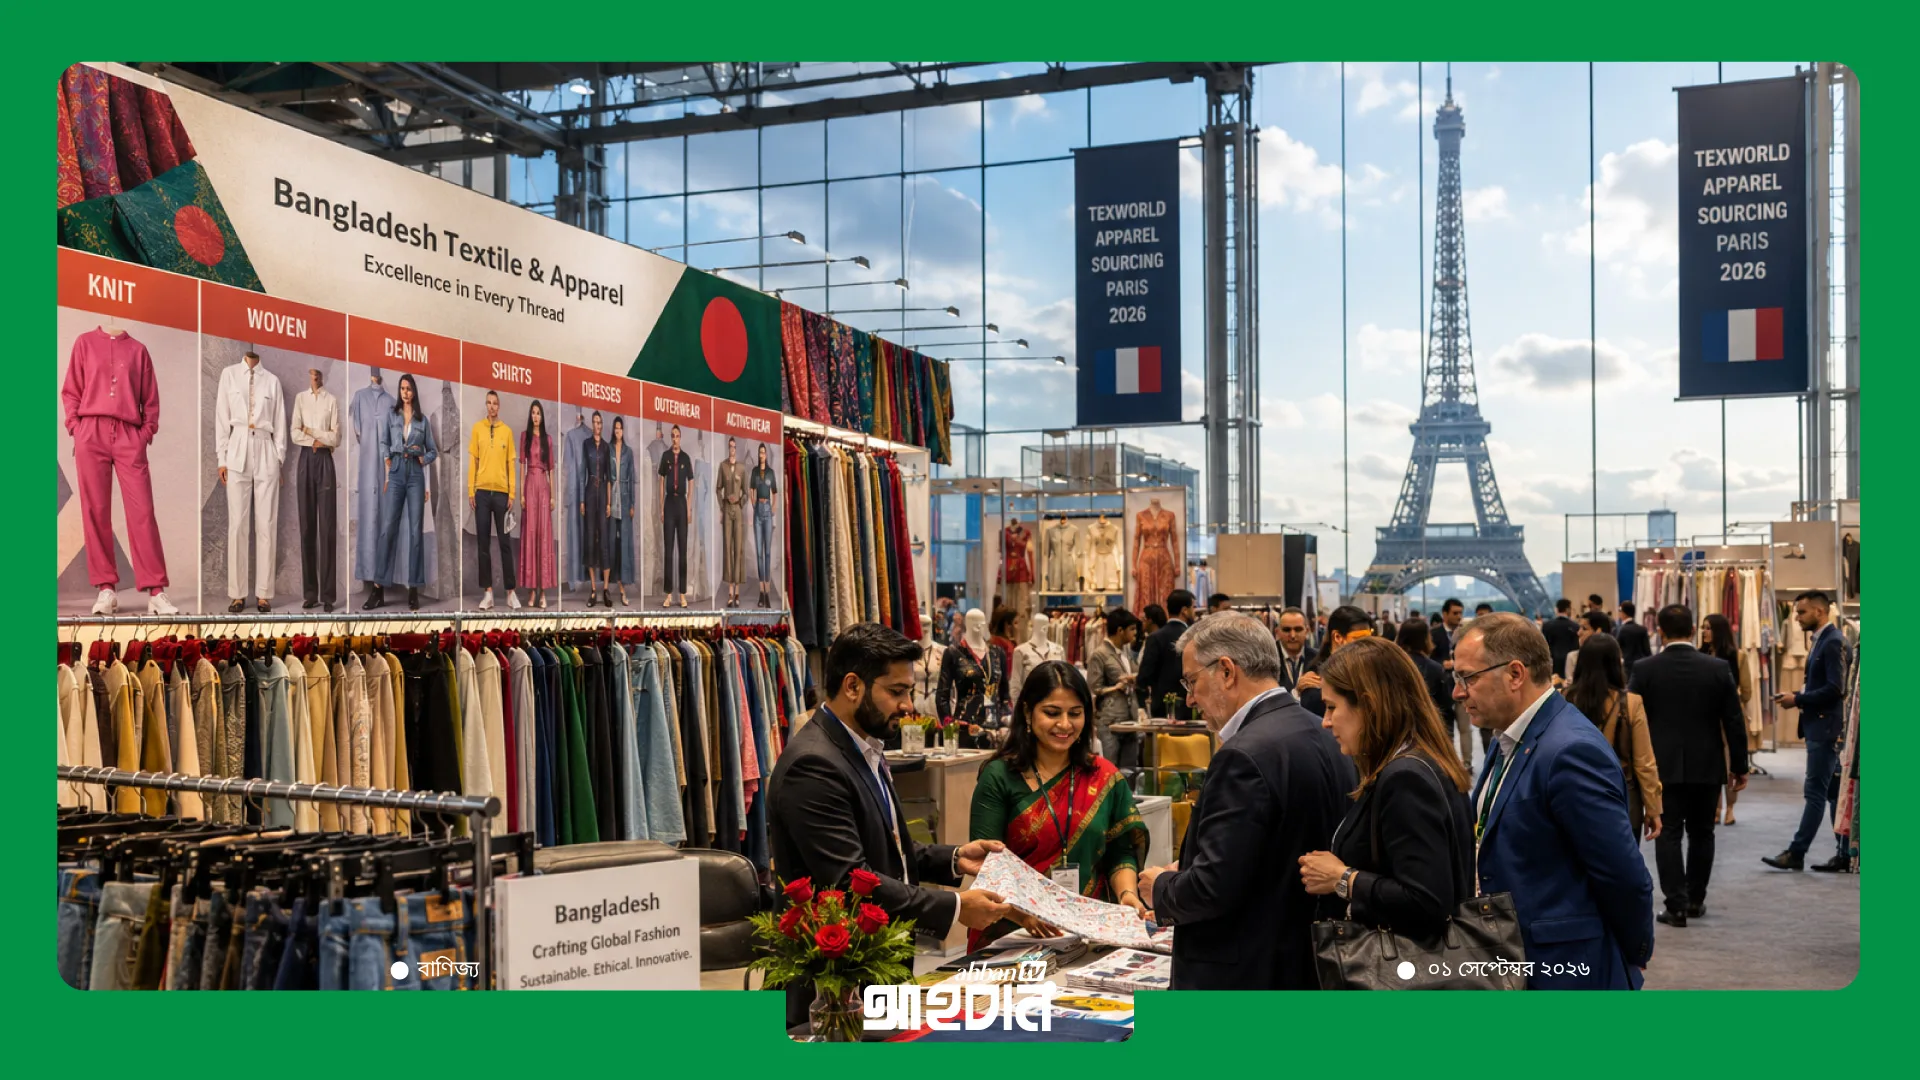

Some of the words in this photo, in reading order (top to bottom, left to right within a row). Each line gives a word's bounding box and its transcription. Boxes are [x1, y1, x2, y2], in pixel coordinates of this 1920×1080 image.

[1694, 143, 1790, 167] TEXWORLD
[1703, 173, 1782, 196] APPAREL
[1088, 201, 1166, 221] TEXWORLD
[1697, 201, 1788, 225] SOURCING
[274, 177, 437, 251] Bangladesh
[443, 230, 522, 276] Textile
[528, 257, 544, 283] &
[550, 265, 624, 306] Apparel
[1095, 227, 1160, 247] APPAREL
[1716, 232, 1769, 252] PARIS
[1091, 252, 1164, 273] SOURCING
[1720, 261, 1767, 282] 2026
[88, 273, 136, 304] KNIT
[364, 253, 452, 293] Excellence
[456, 278, 470, 299] in
[474, 284, 515, 313] Every
[518, 295, 565, 323] Thread
[1106, 279, 1149, 297] PARIS
[247, 307, 307, 339] WOVEN
[1109, 306, 1147, 324] 2026
[384, 337, 429, 364] DENIM
[491, 361, 532, 386] SHIRTS
[581, 381, 622, 404] DRESSES
[654, 396, 700, 420] OUTERWEAR
[726, 411, 771, 435] ACTIVEWEAR
[555, 892, 660, 924] Bangladesh
[532, 939, 588, 960] Crafting
[591, 930, 632, 951] Global
[635, 925, 681, 944] Fashion
[520, 965, 591, 989] Sustainable.
[594, 957, 633, 976] Ethical.
[636, 948, 693, 969] Innovative.
